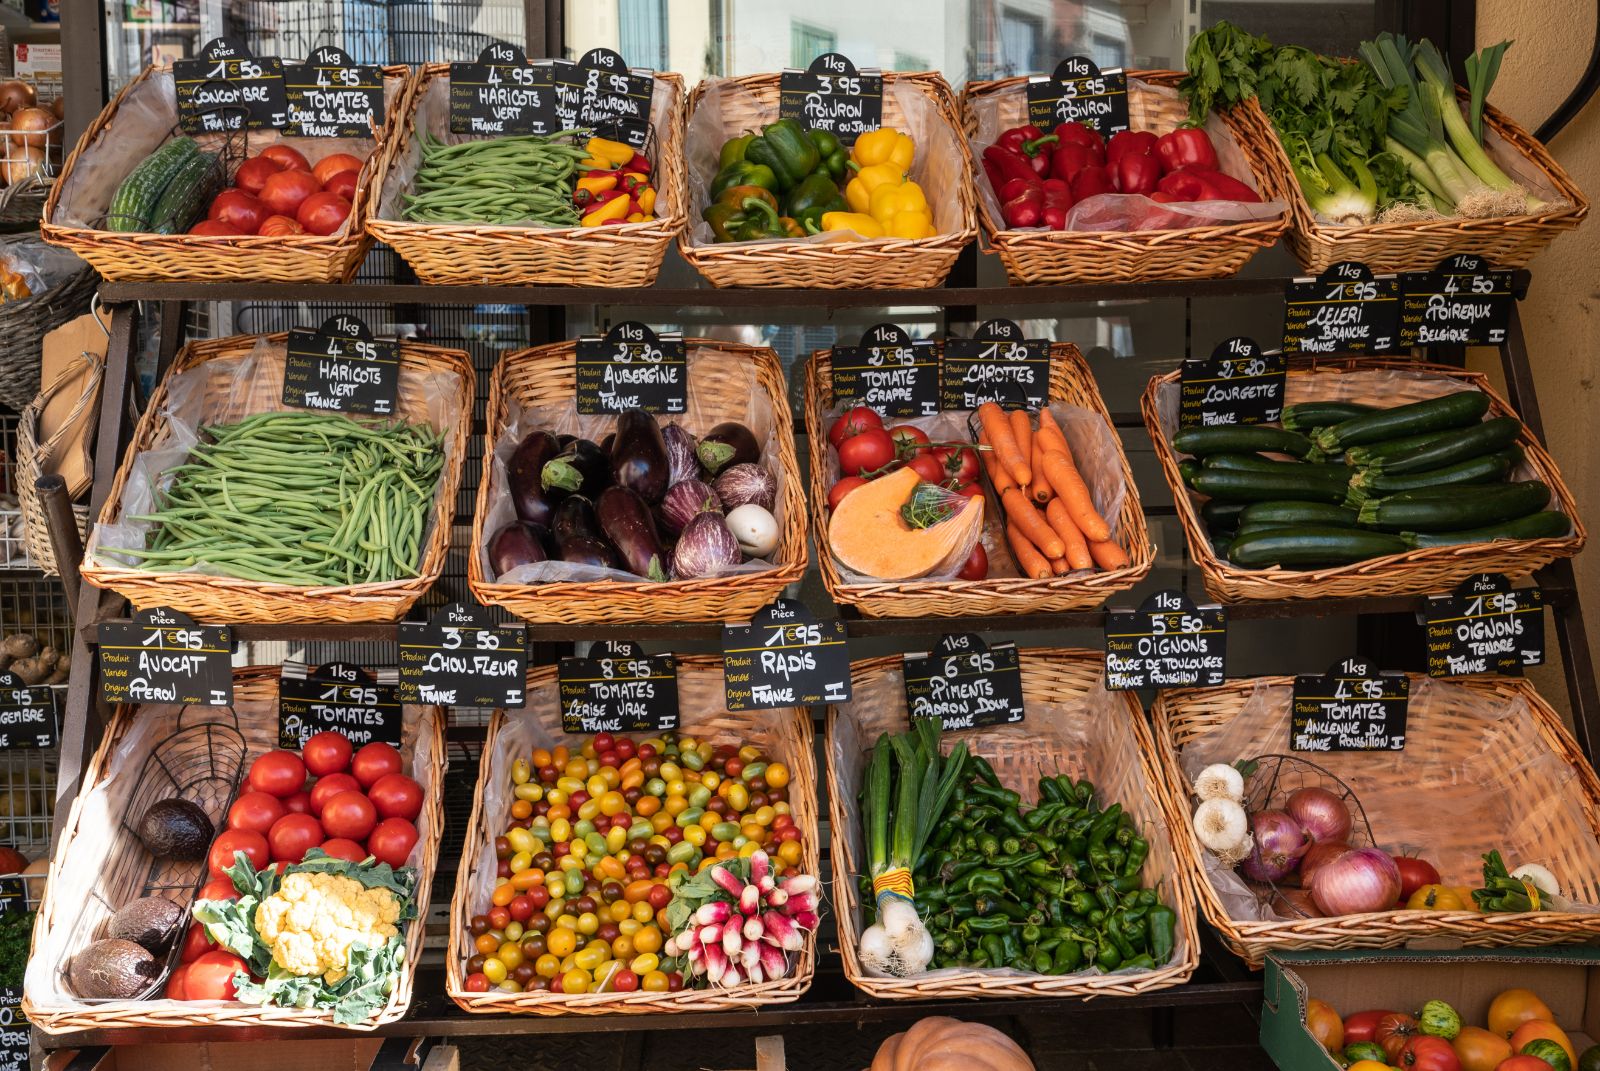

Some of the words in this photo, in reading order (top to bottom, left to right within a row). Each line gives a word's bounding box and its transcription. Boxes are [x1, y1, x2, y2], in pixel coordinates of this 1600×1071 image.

[217, 39, 226, 47] la
[317, 49, 340, 64] 1kg
[490, 45, 513, 60] 1kg
[591, 51, 614, 66] 1kg
[823, 55, 846, 72] 1kg
[1067, 59, 1088, 74] 1kg
[303, 90, 369, 108] TOMATES
[492, 106, 521, 119] VERT
[301, 122, 338, 137] FRANCE
[471, 117, 503, 133] FRANCE
[809, 119, 836, 130] VERT
[1454, 255, 1478, 269] 1kg
[1338, 264, 1361, 278] 1kg
[335, 317, 359, 335] 1kg
[618, 324, 643, 340] 1kg
[873, 326, 897, 342] 1kg
[987, 321, 1011, 337] 1kg
[1318, 325, 1369, 341] BRANCHE
[1229, 338, 1251, 356] 1kg
[1300, 337, 1335, 353] FRANCE
[861, 367, 918, 386] TOMATE
[962, 364, 1034, 383] CAROTTES
[329, 382, 358, 396] VERT
[866, 387, 912, 401] GRAPPE
[1201, 383, 1278, 403] COURGETTE
[304, 391, 340, 409] FRANCE
[598, 390, 640, 413] FRANCE
[1201, 410, 1237, 426] FRANCE
[777, 599, 785, 609] la
[1154, 592, 1180, 609] 1kg
[149, 615, 176, 624] Pièce
[448, 611, 473, 622] Pièce
[770, 608, 794, 619] Pièce
[605, 640, 631, 656] 1kg
[942, 635, 969, 651] 1kg
[1467, 637, 1515, 655] TENDRE
[138, 650, 207, 680] AVOCAT
[1106, 652, 1143, 671] ROUGE
[1144, 658, 1161, 670] DE
[1341, 658, 1367, 675] 1kg
[1446, 654, 1487, 675] FRANCE
[329, 663, 356, 680] 1kg
[1107, 673, 1143, 688] FRANCE
[129, 677, 176, 701] PEROU
[418, 684, 456, 705] FRANCE
[589, 681, 655, 699] TOMATES
[751, 684, 795, 706] FRANCE
[616, 699, 648, 720] VRAC
[974, 697, 1008, 714] DOUX
[1320, 702, 1386, 719] TOMATES
[310, 704, 384, 725] TOMATES
[581, 717, 622, 731] FRANCE
[1296, 734, 1331, 751] FRANCE
